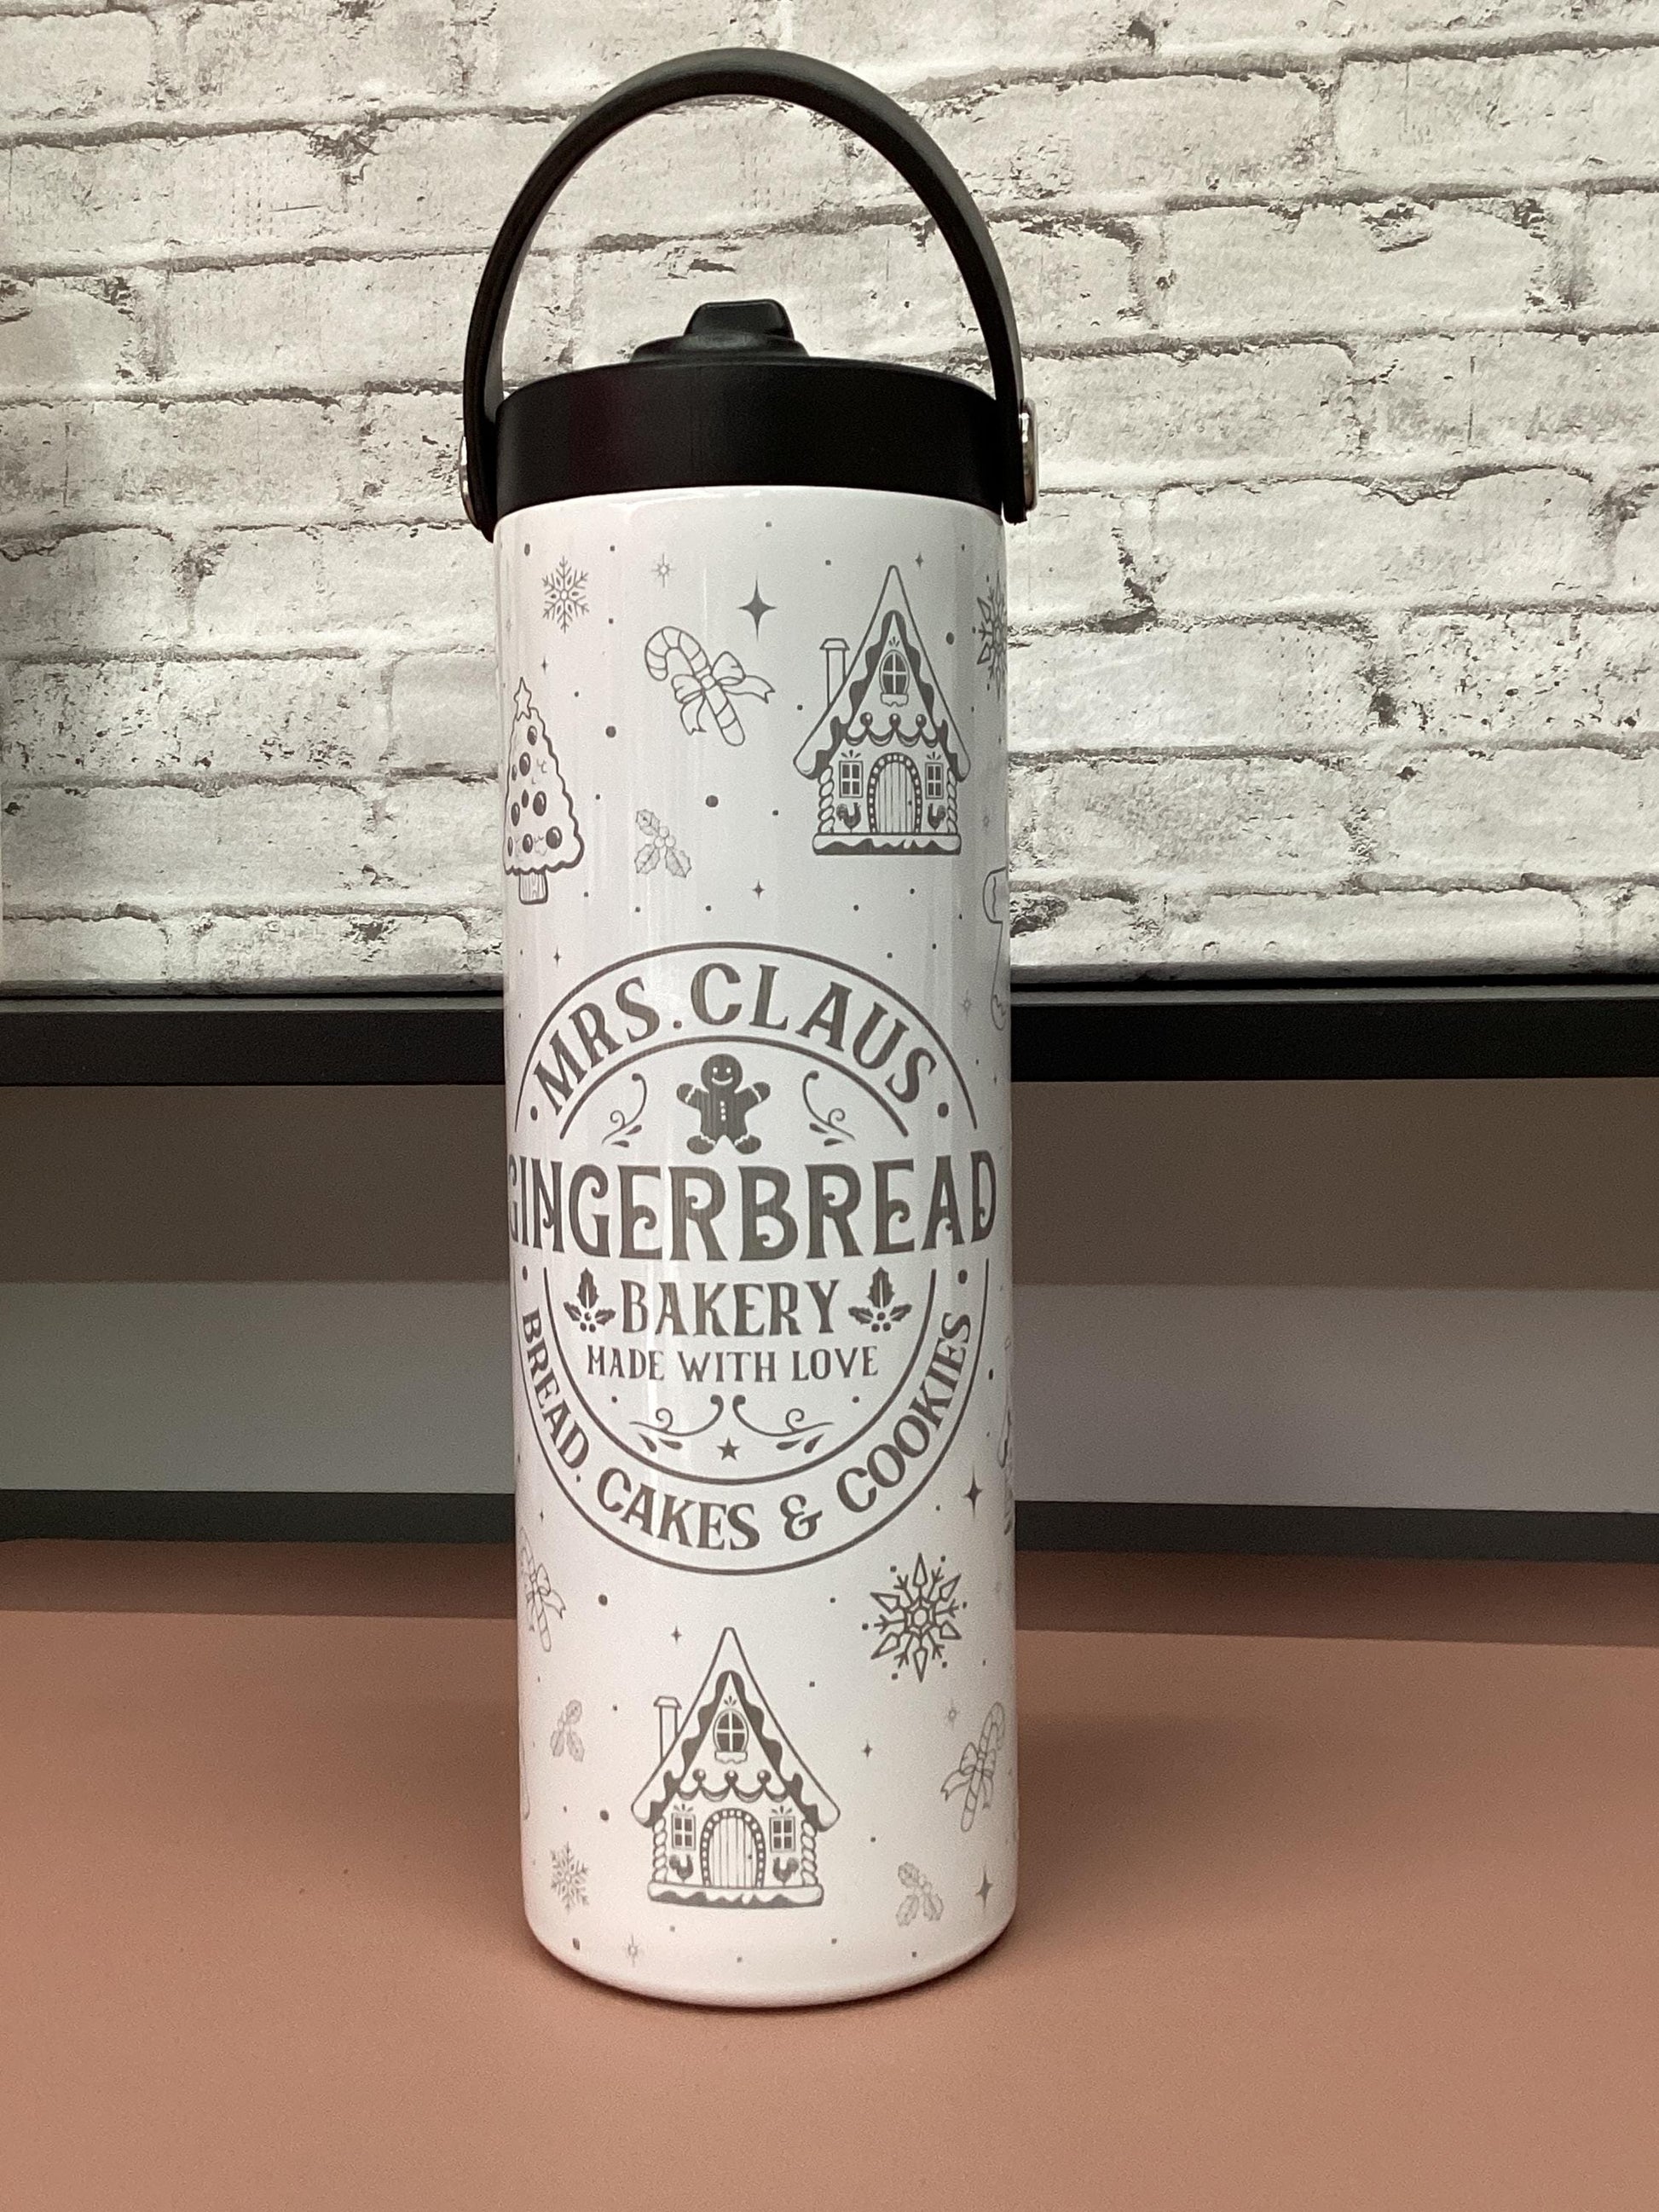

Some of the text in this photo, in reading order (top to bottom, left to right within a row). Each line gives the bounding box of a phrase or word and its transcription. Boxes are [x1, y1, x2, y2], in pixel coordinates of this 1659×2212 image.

[532, 962, 938, 1117] MRS. CLAUS
[508, 1149, 997, 1262] GINGERBREAD
[587, 1344, 879, 1383] MADE WITH LOVE
[621, 1279, 841, 1337] BAKERY
[597, 1468, 760, 1551] CAKES
[779, 1493, 822, 1541] &
[835, 1312, 972, 1513] COOKIES
